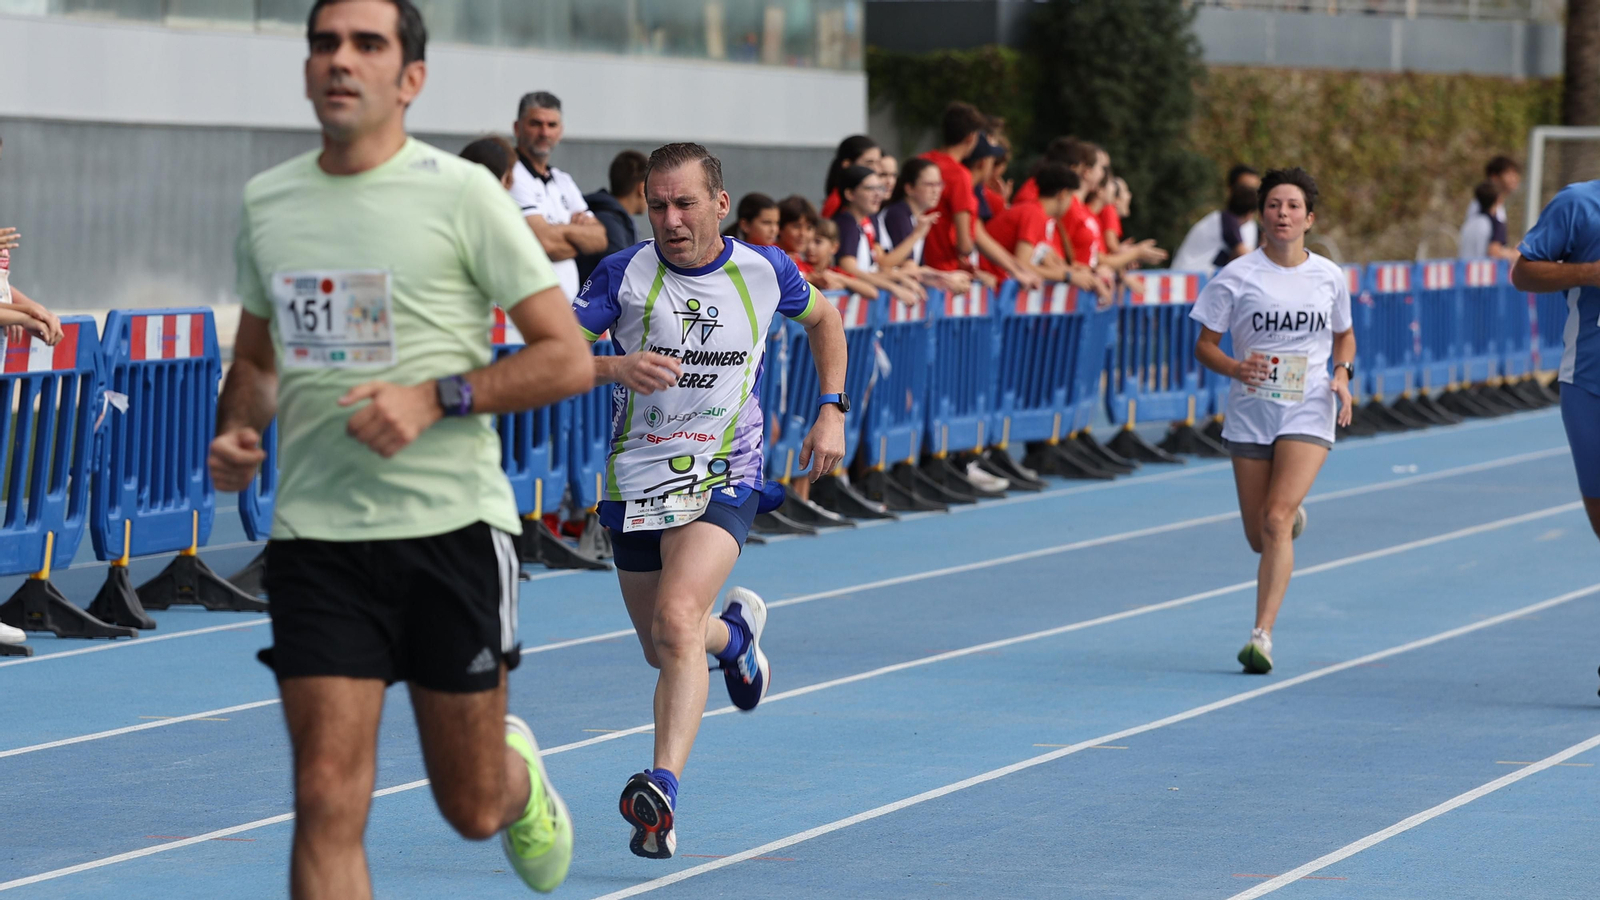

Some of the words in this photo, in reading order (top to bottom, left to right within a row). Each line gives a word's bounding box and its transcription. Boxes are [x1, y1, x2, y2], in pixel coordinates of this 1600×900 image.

[288, 300, 331, 332] 151
[1252, 311, 1328, 332] CHAPIN
[676, 373, 718, 389] EREZ
